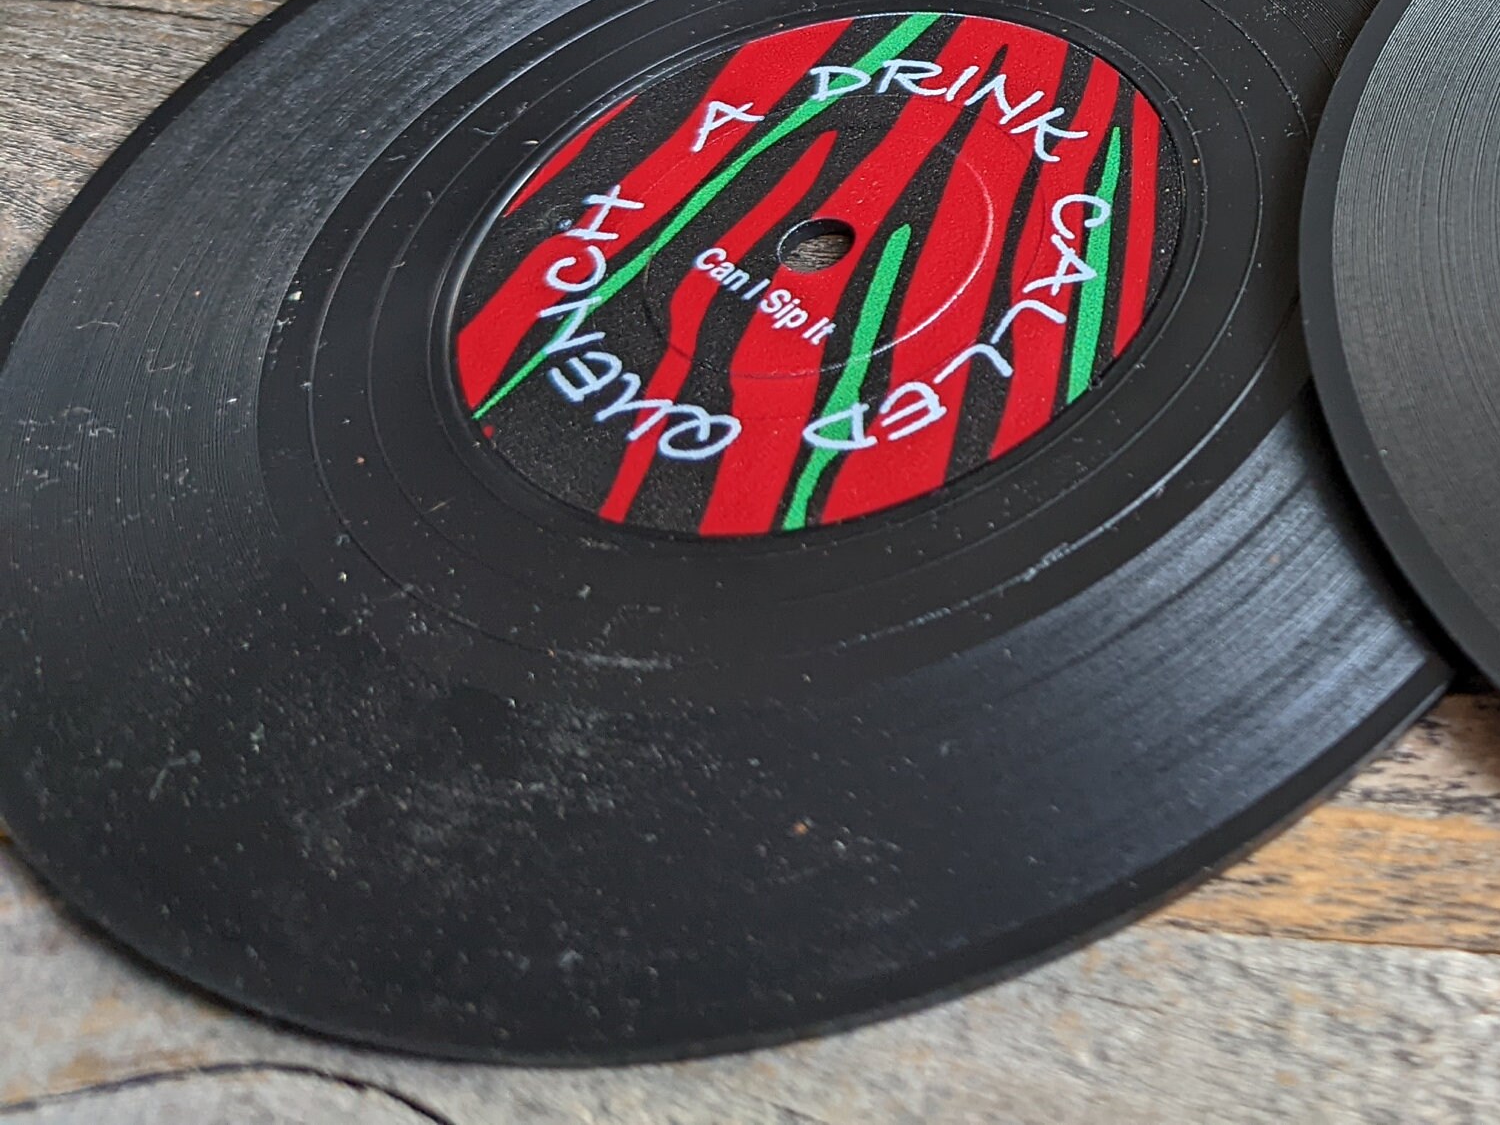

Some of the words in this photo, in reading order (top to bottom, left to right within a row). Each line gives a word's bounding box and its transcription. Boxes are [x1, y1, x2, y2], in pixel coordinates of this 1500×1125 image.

[692, 100, 765, 153] A
[809, 58, 1089, 163] DRINK
[537, 183, 743, 461] QUENCH
[693, 247, 751, 292] Can
[742, 278, 771, 301] I
[759, 288, 809, 330] Sip
[801, 316, 838, 346] It
[801, 193, 1112, 451] CALLED
